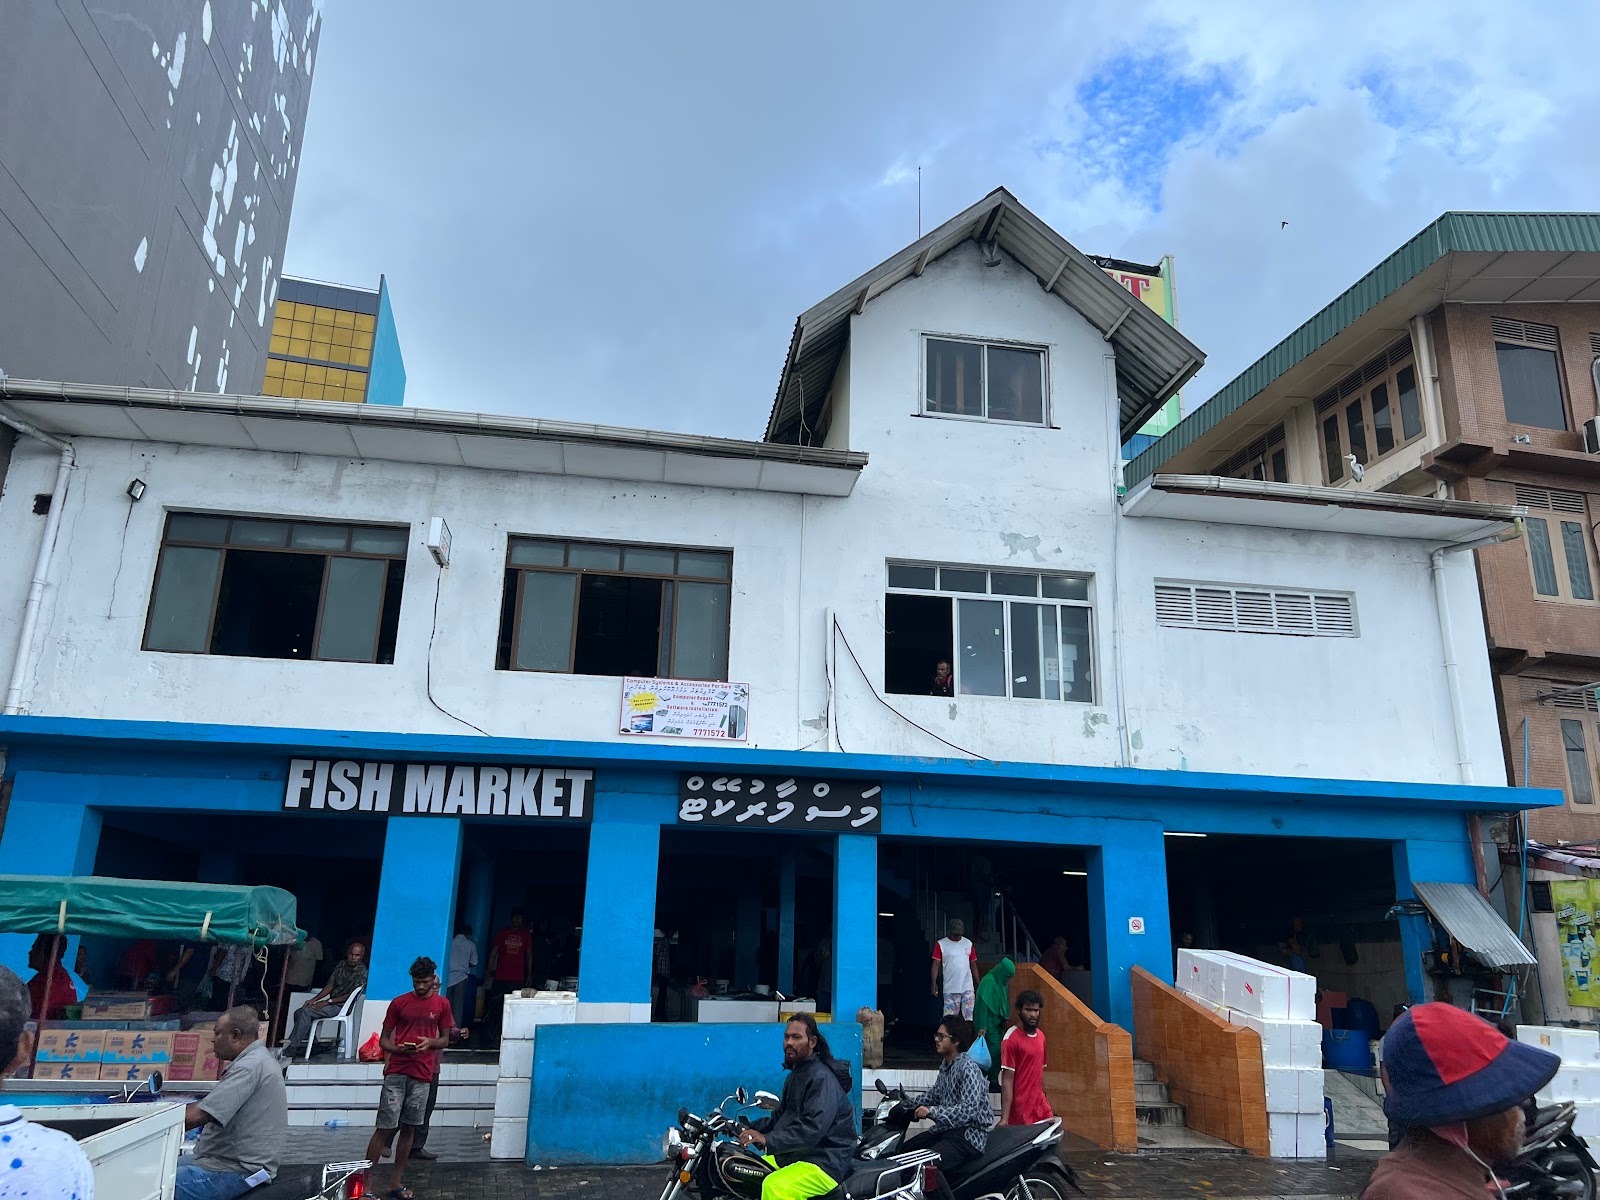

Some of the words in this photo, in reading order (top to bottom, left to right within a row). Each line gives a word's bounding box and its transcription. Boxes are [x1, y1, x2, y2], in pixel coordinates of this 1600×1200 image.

[693, 728, 726, 738] 7771572
[284, 758, 395, 812] FISH
[402, 763, 594, 818] MARKET
